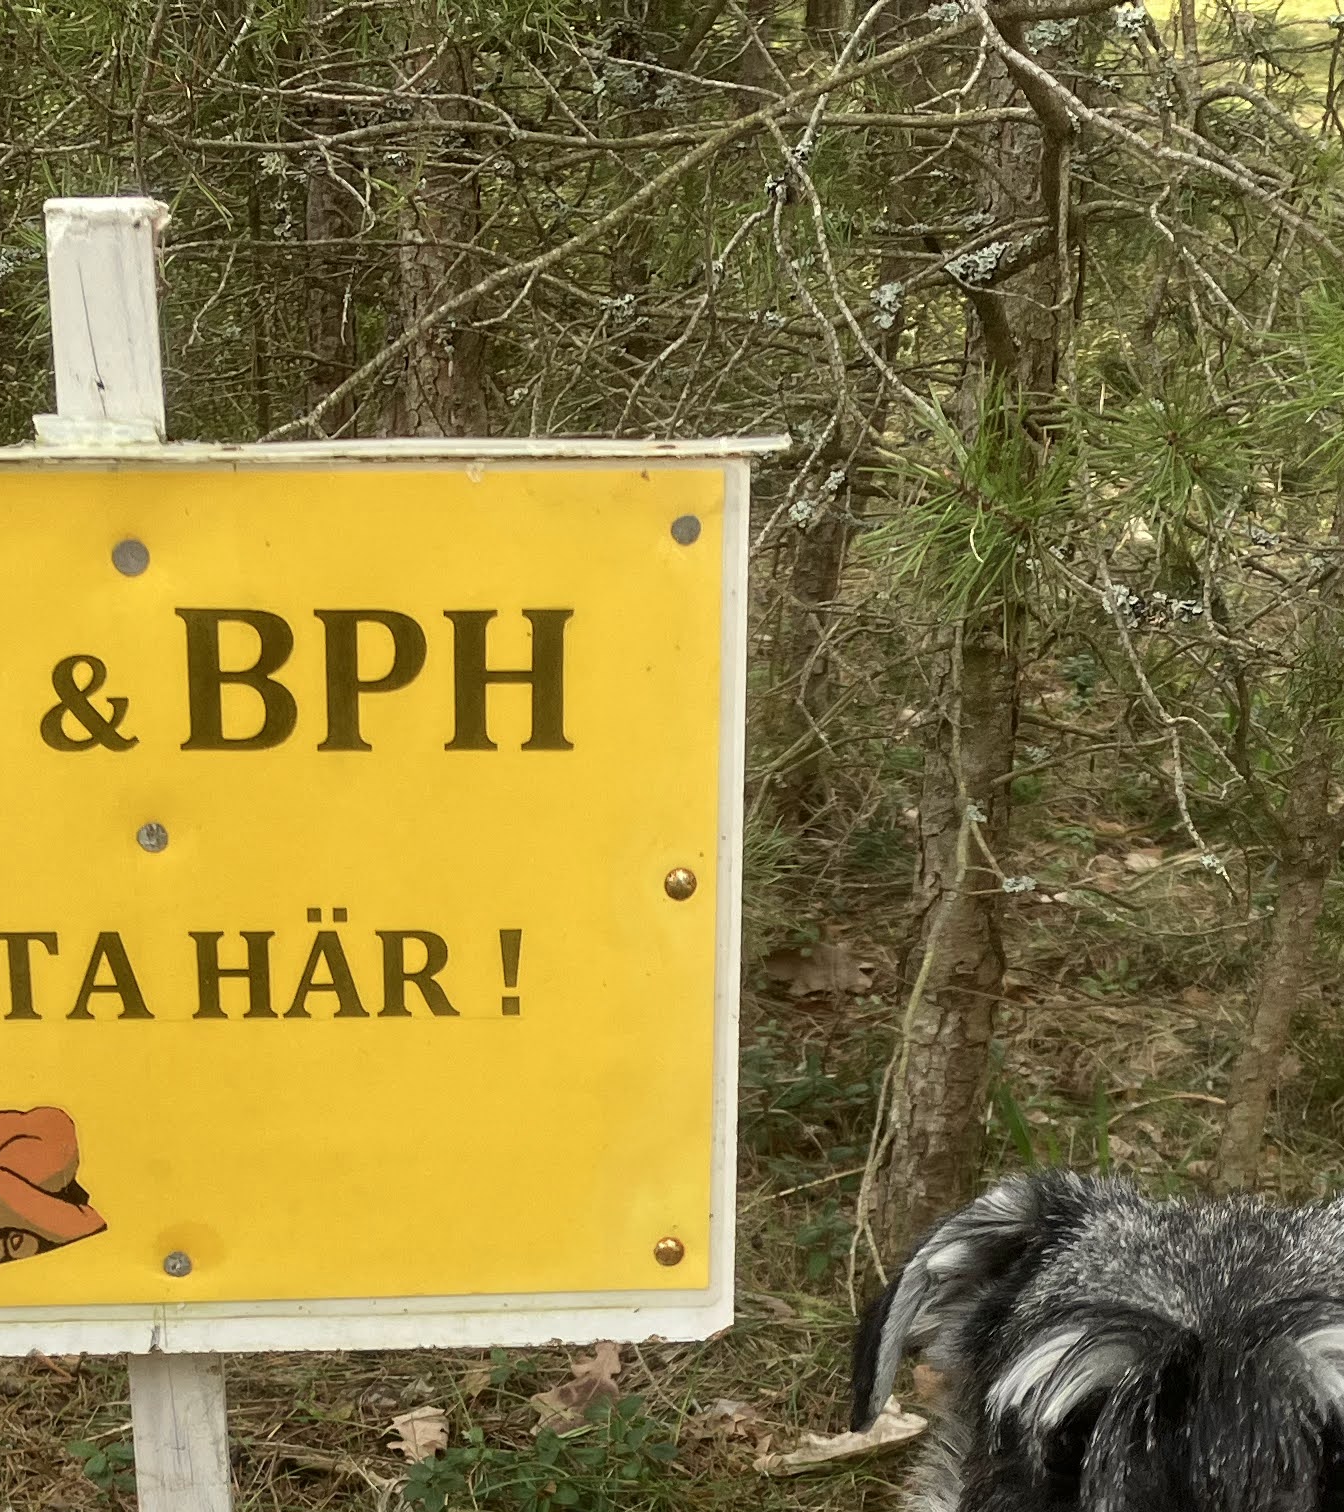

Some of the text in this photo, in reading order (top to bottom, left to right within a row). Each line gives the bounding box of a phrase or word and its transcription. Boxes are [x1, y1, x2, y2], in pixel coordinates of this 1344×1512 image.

[39, 654, 139, 752] &
[175, 607, 575, 752] BPH
[191, 907, 460, 1020] HÄR
[499, 929, 523, 1017] !
